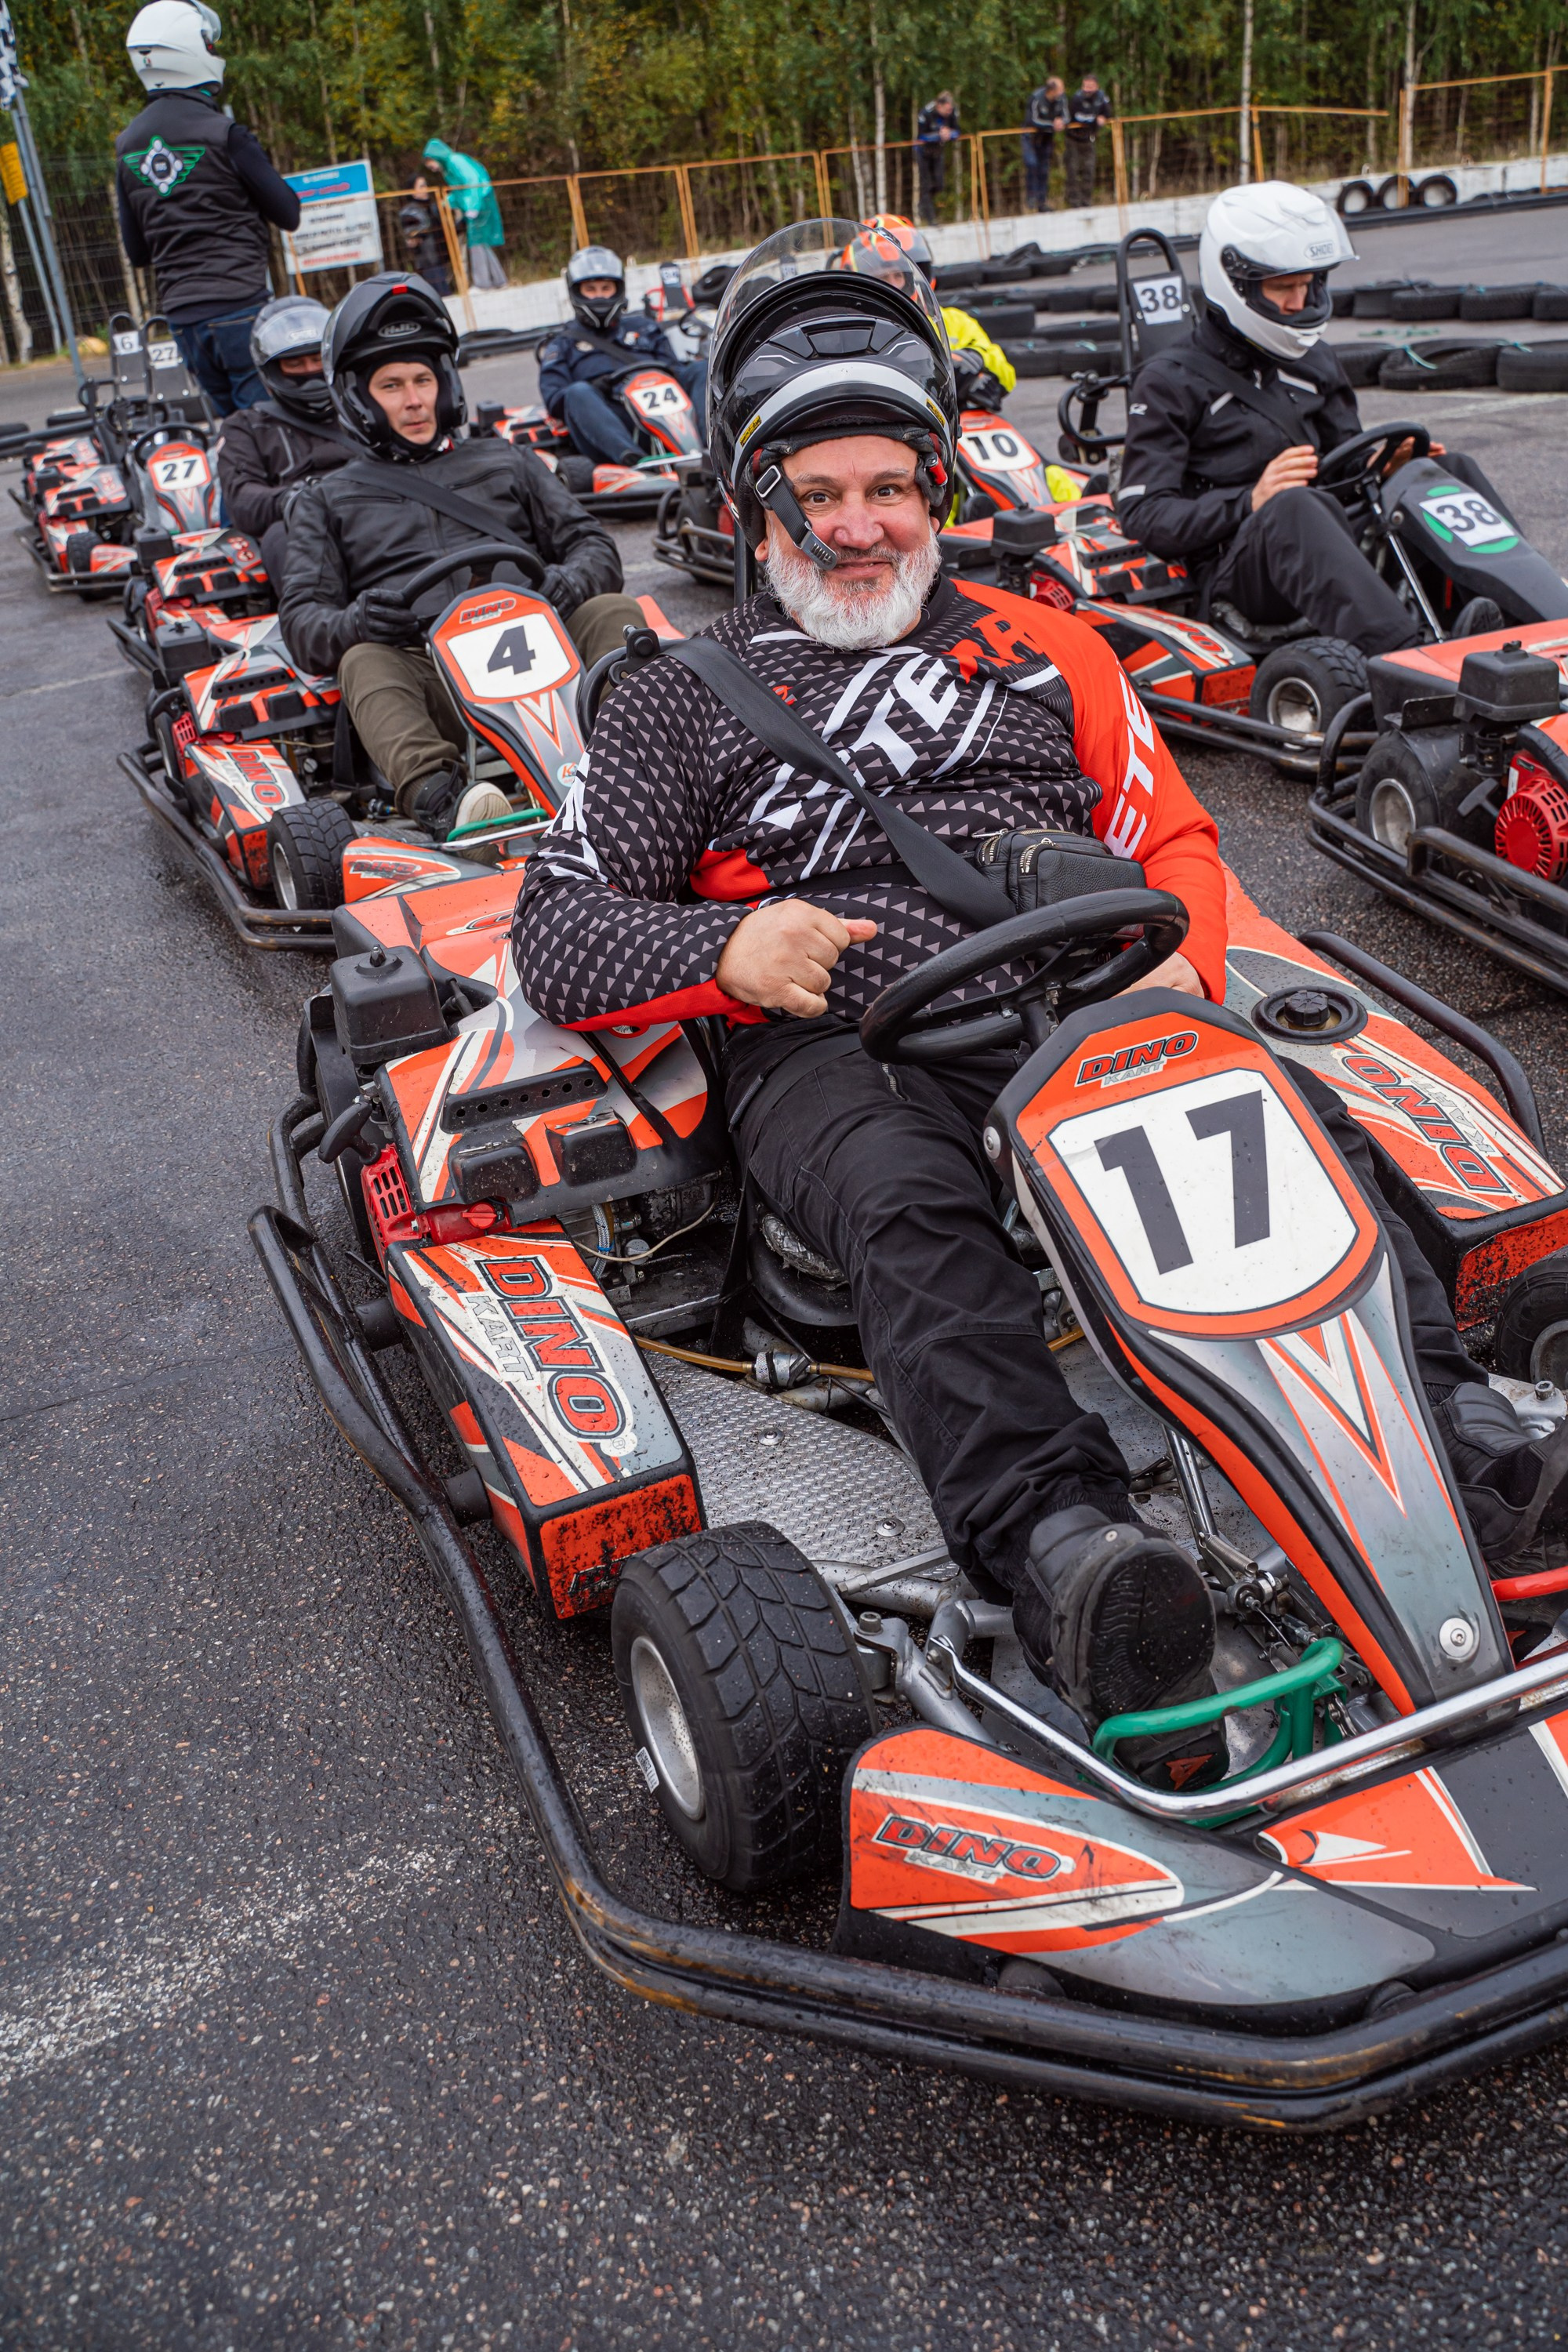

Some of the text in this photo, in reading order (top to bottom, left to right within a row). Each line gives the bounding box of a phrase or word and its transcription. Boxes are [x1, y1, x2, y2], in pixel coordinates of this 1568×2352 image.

[1141, 285, 1180, 313] 38
[121, 336, 132, 350] 6
[153, 347, 174, 362] 27
[643, 387, 677, 409] 24
[967, 434, 1018, 460] 10
[163, 459, 197, 483] 27
[1436, 500, 1501, 532] 38
[461, 599, 514, 623] DINO
[487, 625, 536, 675] 4
[227, 751, 285, 805] DINO
[1077, 1033, 1197, 1084] DINO
[1104, 1061, 1164, 1085] KART
[1342, 1055, 1512, 1194] DINO
[1411, 1080, 1496, 1152] KART
[1094, 1089, 1270, 1275] 17
[466, 1295, 534, 1381] KART
[474, 1258, 626, 1439] DINO
[876, 1816, 1062, 1878] DINO
[908, 1851, 1000, 1879] KART
